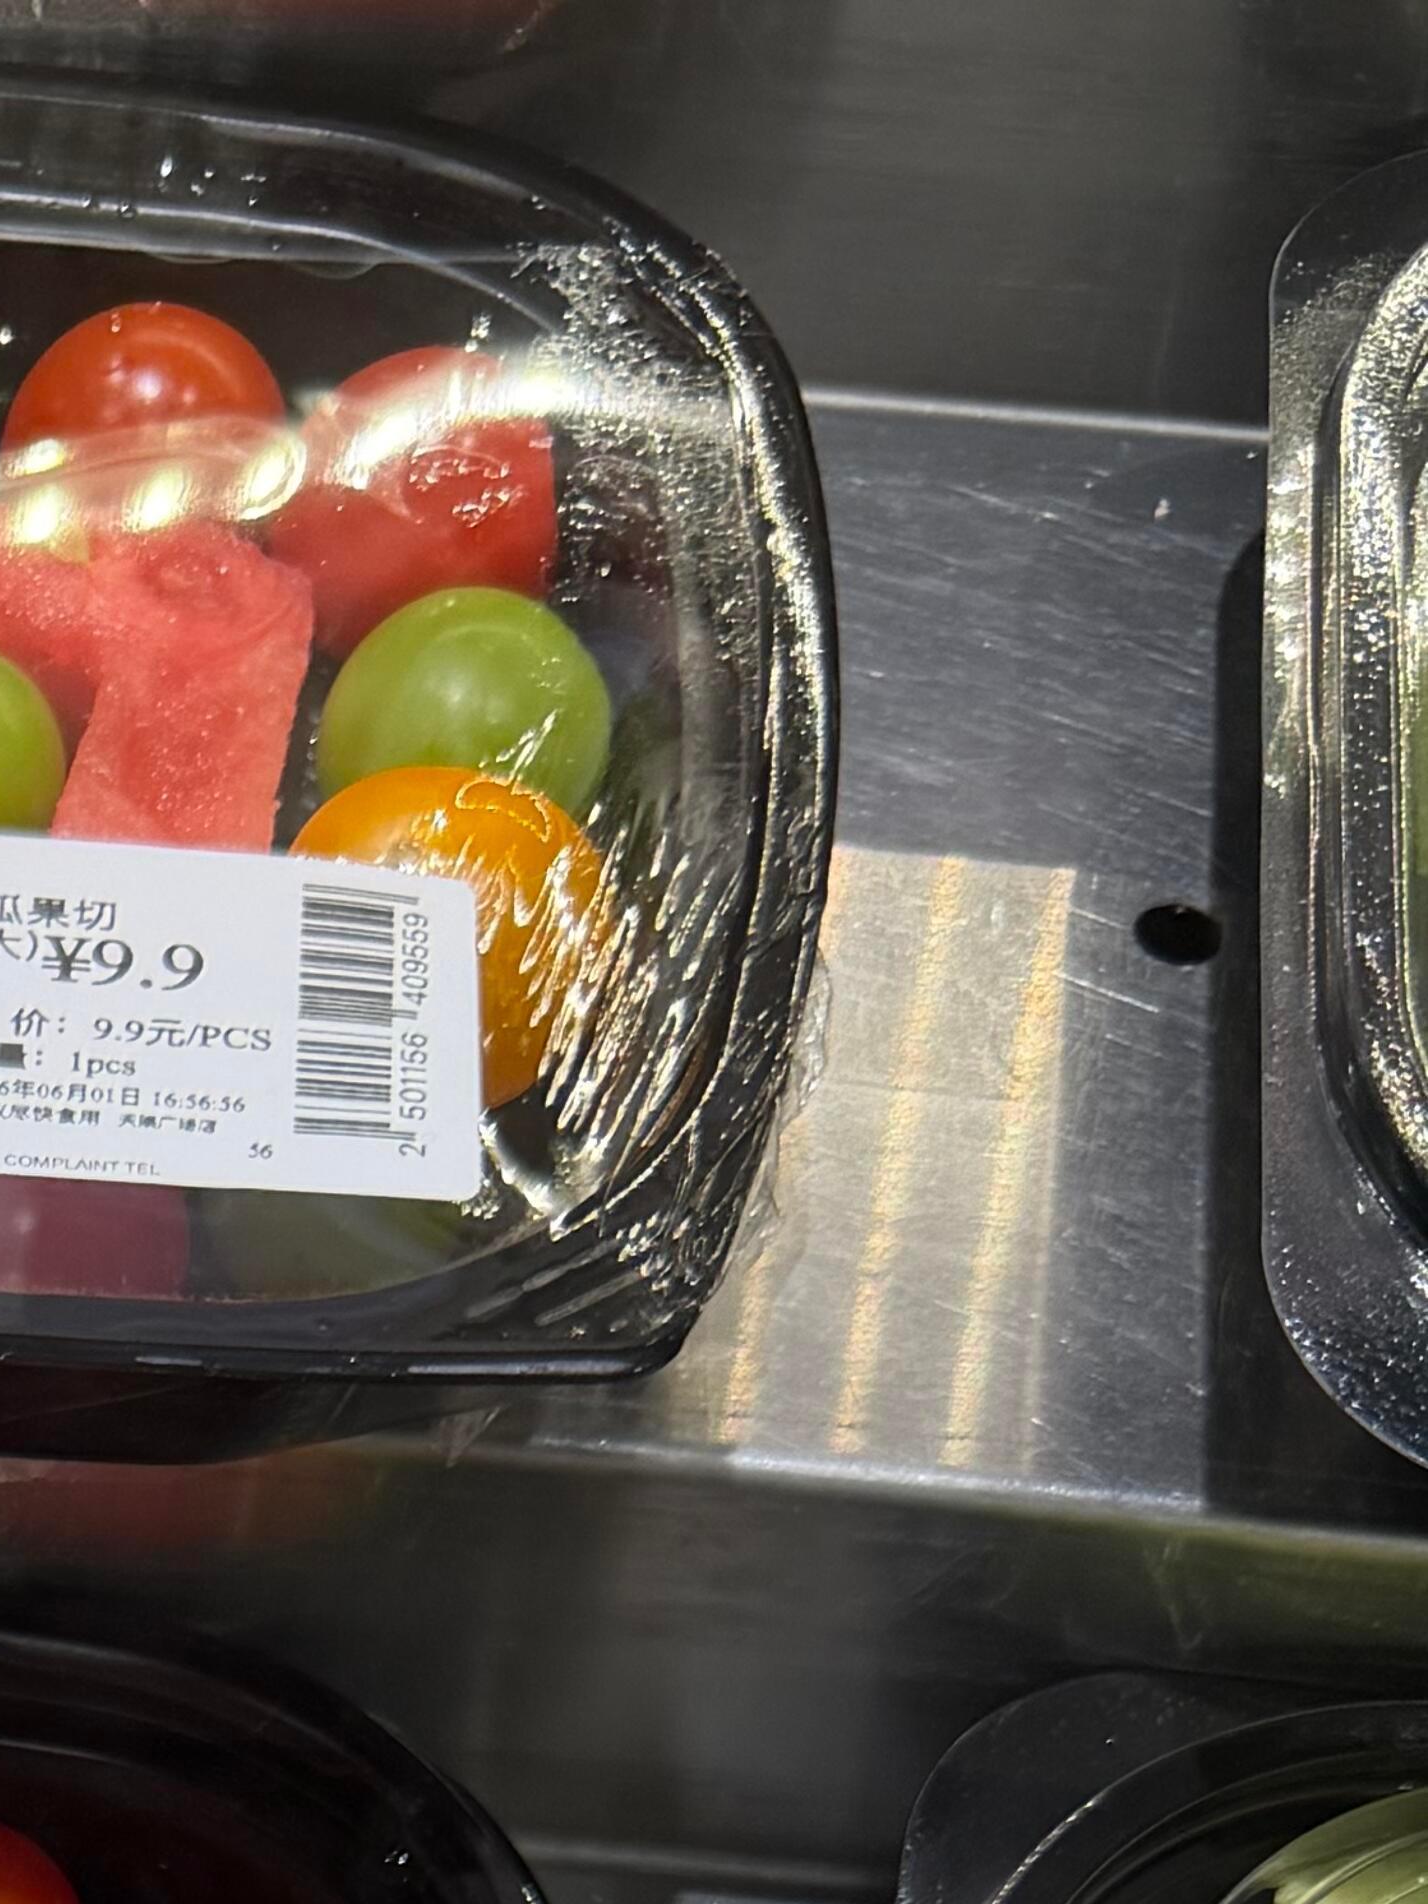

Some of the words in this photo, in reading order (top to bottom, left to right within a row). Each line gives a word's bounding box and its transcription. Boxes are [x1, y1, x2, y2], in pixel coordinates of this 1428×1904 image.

[41, 934, 205, 992] ¥9.9
[401, 911, 430, 1008] 409559
[93, 1016, 273, 1051] 9.9元/PCS
[70, 1051, 137, 1078] 1pcs
[399, 1032, 429, 1122] 501156
[152, 1090, 247, 1114] 16:56:56
[3, 1153, 120, 1175] COMPLAINT
[123, 1160, 161, 1177] TEL
[248, 1142, 274, 1160] 56
